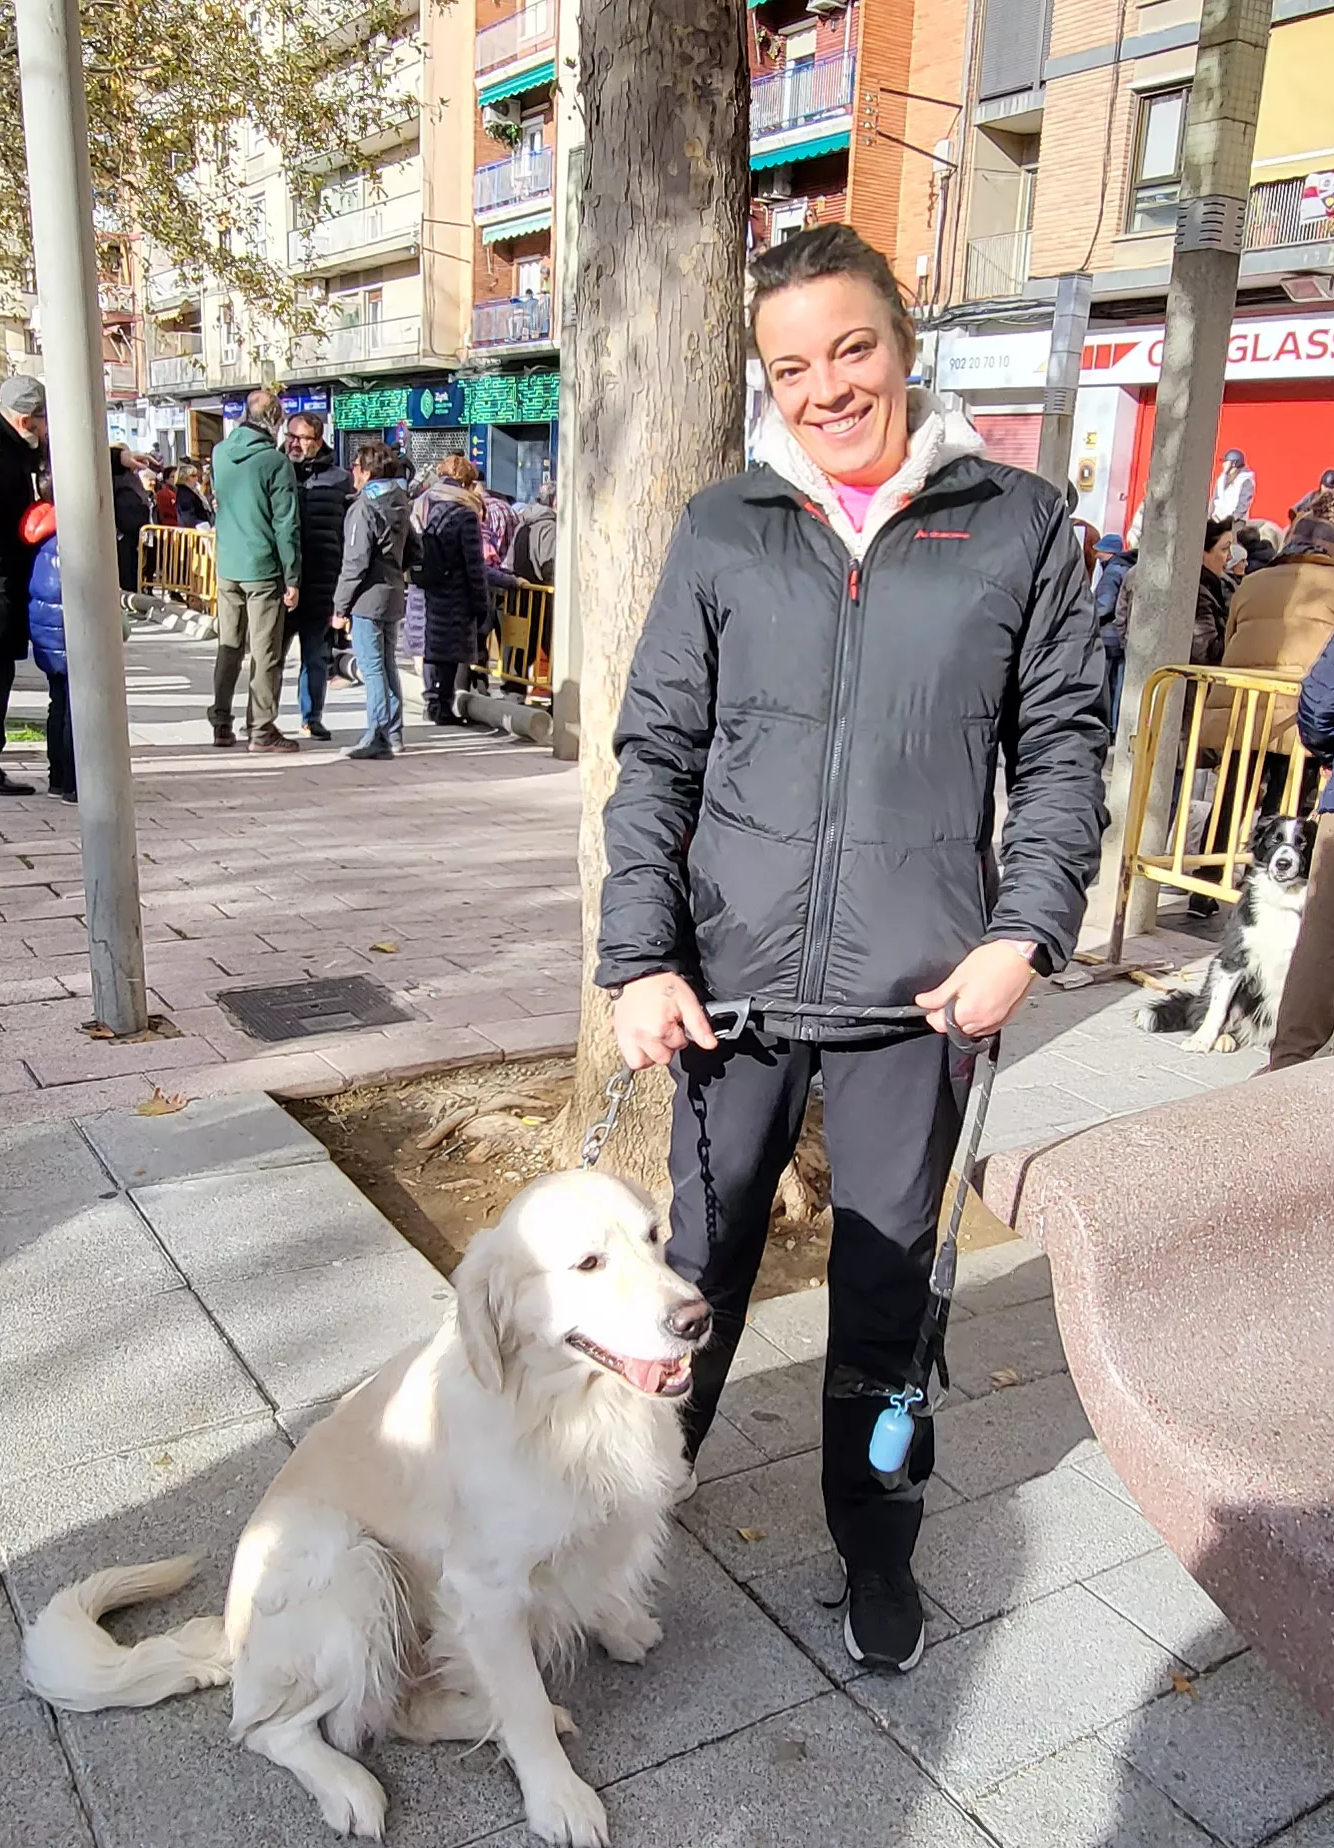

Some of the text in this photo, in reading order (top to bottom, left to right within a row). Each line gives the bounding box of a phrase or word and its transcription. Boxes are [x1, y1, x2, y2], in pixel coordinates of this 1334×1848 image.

[949, 355, 1011, 371] 902 20 70 10
